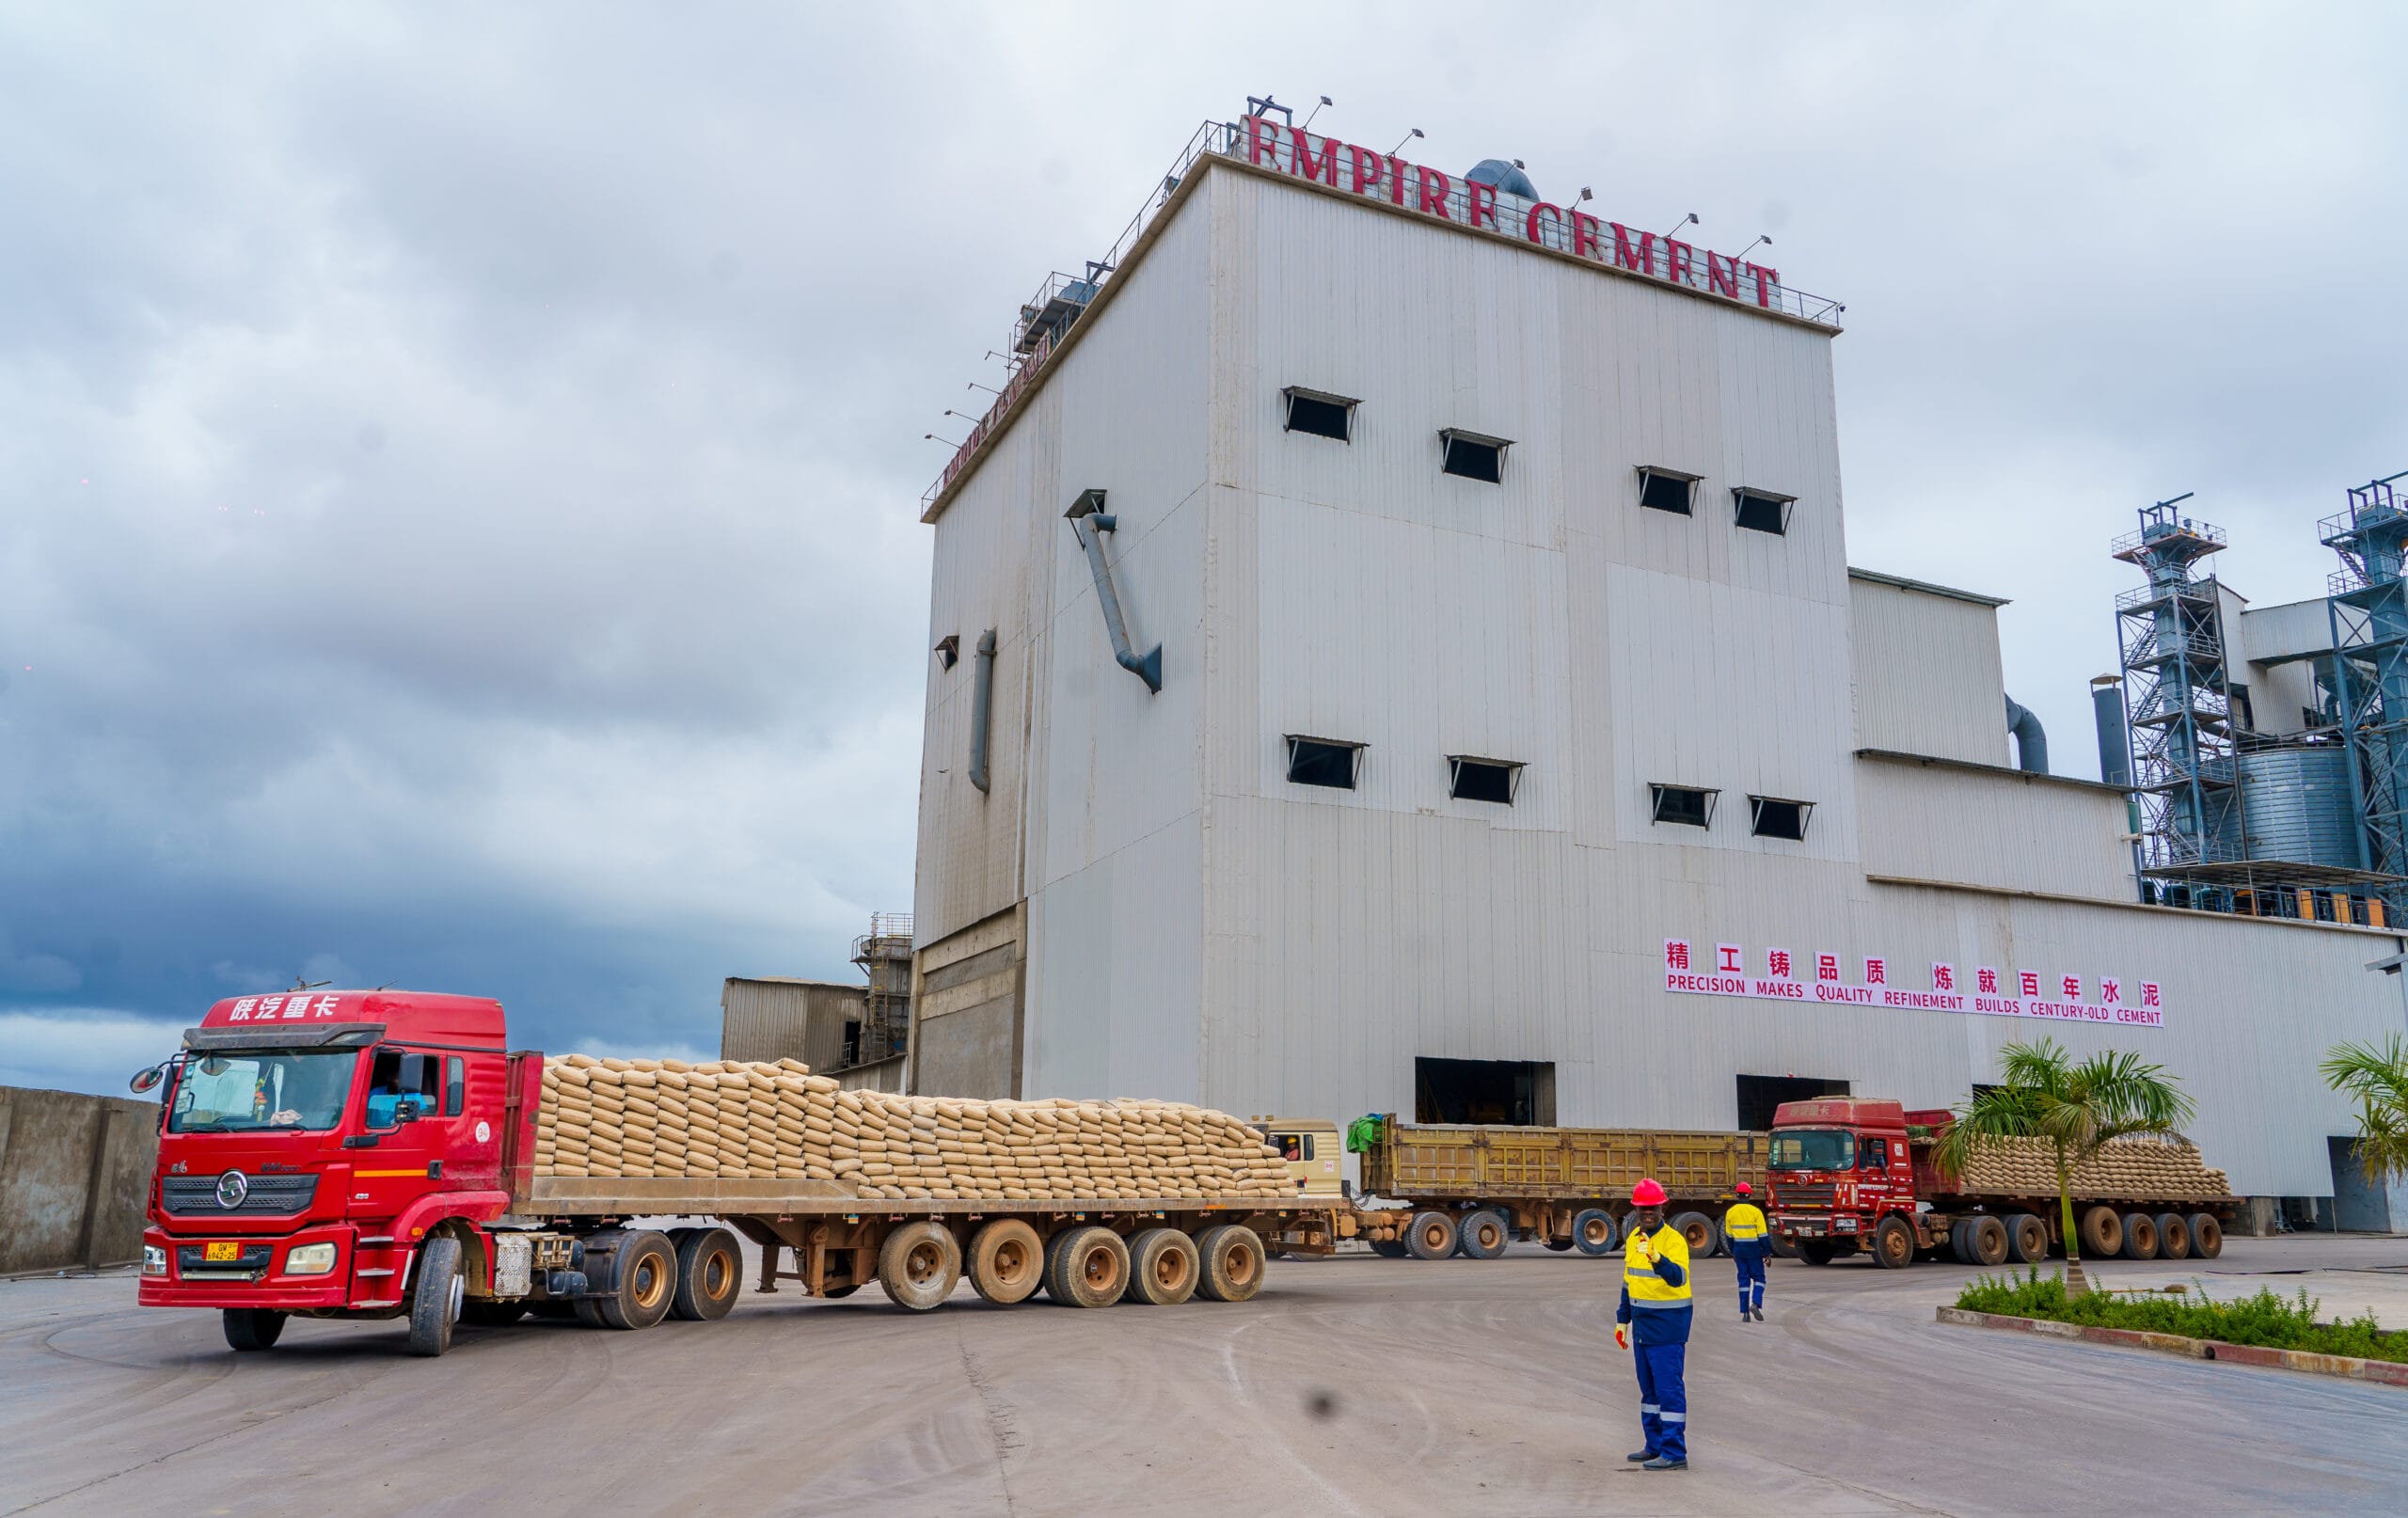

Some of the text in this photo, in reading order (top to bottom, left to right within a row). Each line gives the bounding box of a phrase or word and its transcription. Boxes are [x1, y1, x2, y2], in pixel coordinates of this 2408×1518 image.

[1244, 115, 1778, 308] EMPIRE CEMENT
[1667, 941, 2160, 1007] 精工铸品质 炼就百年水泥
[1668, 974, 2161, 1024] PRECISION MAKES QUALITY REFINEMENT BUILDS CENTURY-OLD CEMENT
[230, 995, 340, 1021] 陕汽重卡
